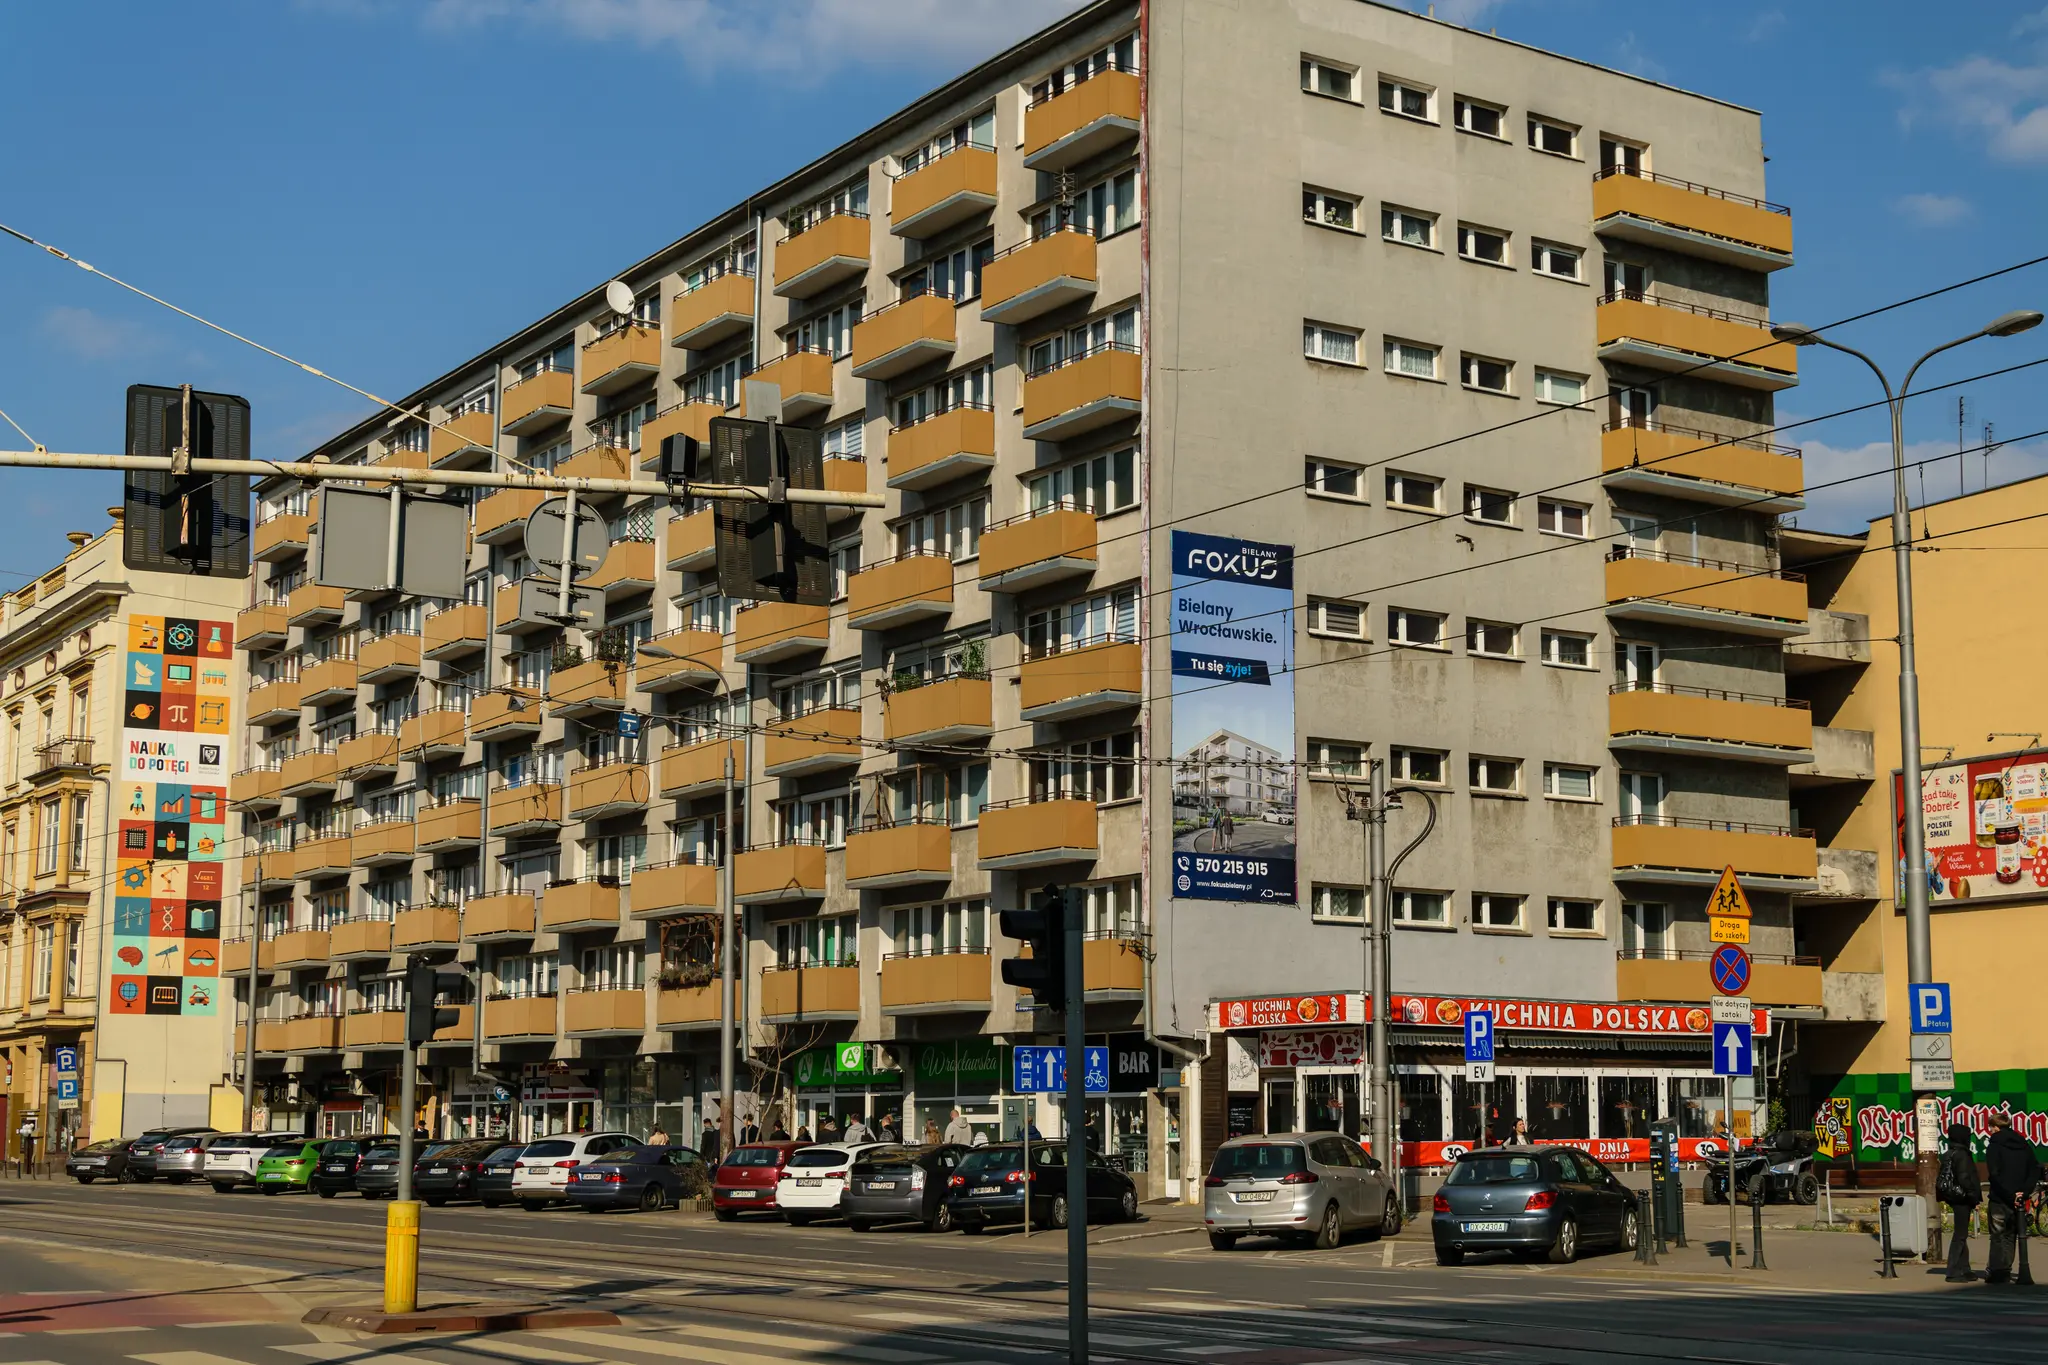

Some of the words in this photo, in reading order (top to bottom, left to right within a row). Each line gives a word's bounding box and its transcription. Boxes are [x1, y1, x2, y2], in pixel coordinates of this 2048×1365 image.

[1242, 547, 1277, 558] BIELANY
[1188, 549, 1278, 580] FOKUS
[1178, 598, 1233, 622] Bielany
[1178, 619, 1277, 644] Wrocławskie.
[1191, 658, 1205, 670] Tu
[1207, 660, 1224, 675] się
[1225, 662, 1252, 677] żyje!
[130, 740, 175, 756] NAUKA
[129, 757, 145, 770] DO
[149, 758, 189, 775] POTĘGI
[1938, 789, 1957, 800] takie
[1926, 800, 1953, 813] Dobre!
[1927, 821, 1952, 830] POLSKIE
[1930, 830, 1950, 838] SMAKI
[1196, 858, 1220, 873] 570
[1223, 860, 1244, 874] 215
[1247, 862, 1268, 876] 915
[1196, 880, 1252, 891] www.fokusbielany.pl
[1720, 920, 1740, 930] Droga
[1726, 932, 1746, 941] szkoły
[1252, 1000, 1292, 1012] KUCHNIA
[1725, 999, 1749, 1010] dotyczy
[1919, 988, 1943, 1027] P
[1252, 1012, 1287, 1025] POLSKA
[1593, 1007, 1680, 1031] POLSKA
[1721, 1010, 1742, 1018] zatoki
[1927, 1020, 1950, 1028] Płatny
[1470, 1015, 1488, 1047] P
[61, 1055, 72, 1070] P
[921, 1046, 997, 1076] Wrocławska
[1119, 1051, 1150, 1074] BAR
[1474, 1066, 1486, 1078] EV
[62, 1082, 73, 1097] P
[1669, 1133, 1675, 1142] P
[1447, 1147, 1463, 1159] 30
[1599, 1142, 1630, 1153] DNIA
[1700, 1143, 1714, 1156] 30
[1240, 1192, 1248, 1200] DX
[1250, 1191, 1269, 1200] 04827
[1471, 1223, 1479, 1231] DX
[1482, 1222, 1503, 1231] 2430A
